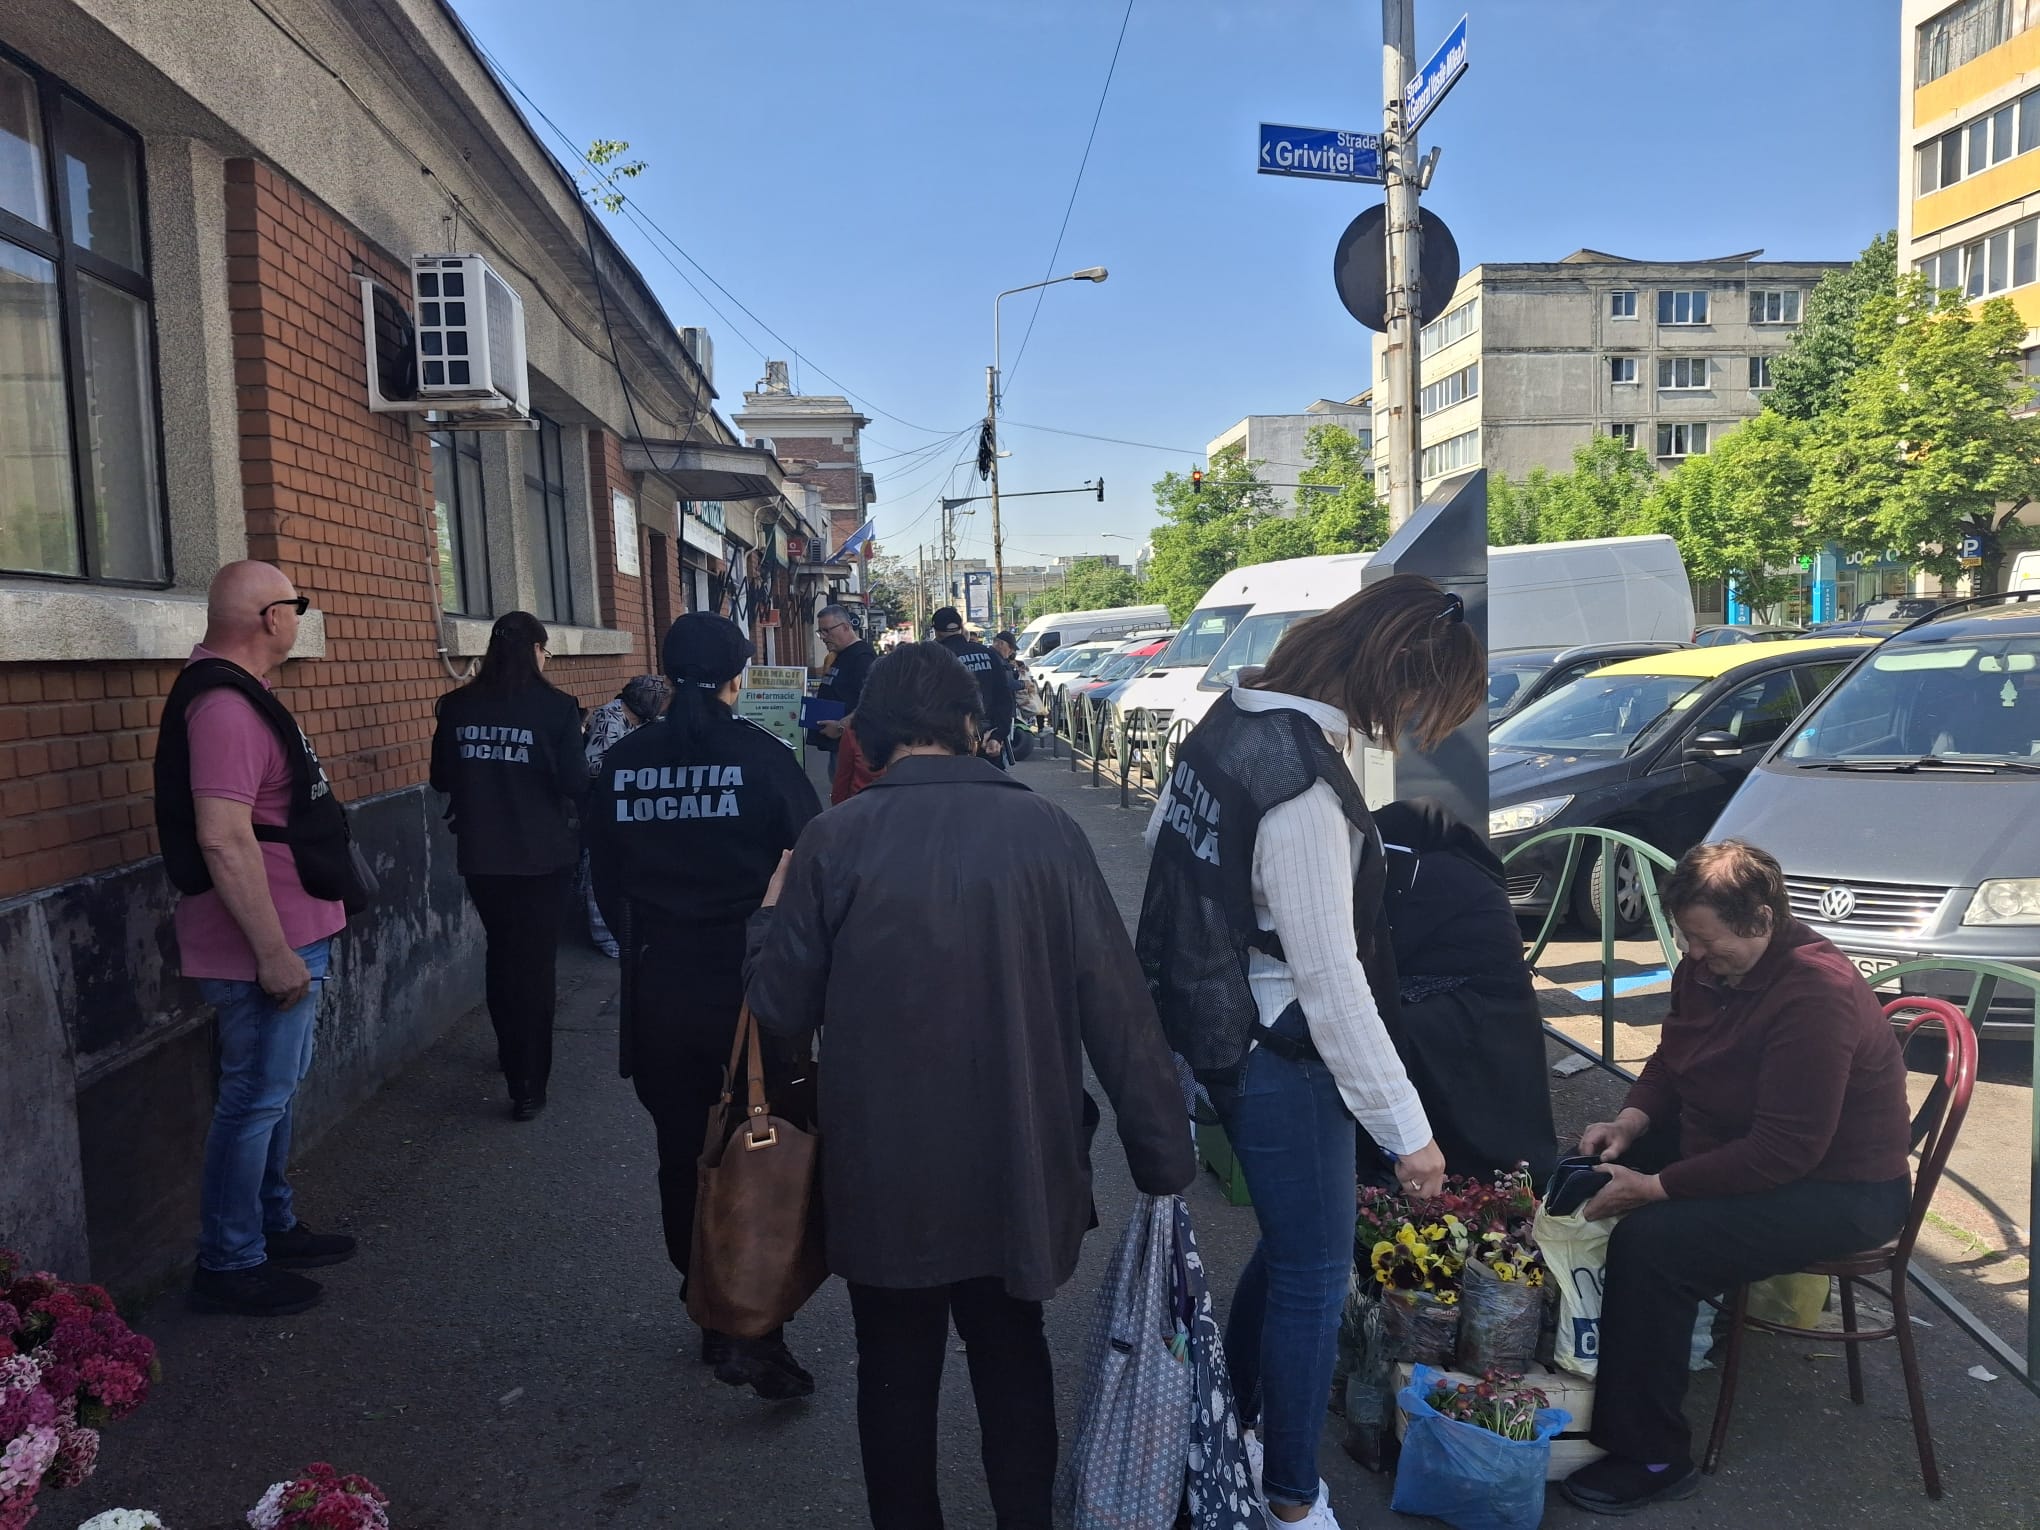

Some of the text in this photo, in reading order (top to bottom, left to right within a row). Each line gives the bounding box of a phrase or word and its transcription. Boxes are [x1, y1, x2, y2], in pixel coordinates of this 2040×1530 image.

[1407, 74, 1423, 100] Strada
[1411, 77, 1430, 122] General
[1431, 61, 1446, 98] Vasile
[1337, 132, 1377, 150] Strada
[1963, 540, 1979, 557] P
[969, 575, 977, 583] P
[460, 744, 529, 763] OCALĂ
[614, 765, 744, 793] POLIȚIA
[617, 789, 740, 822] LOCALĂ
